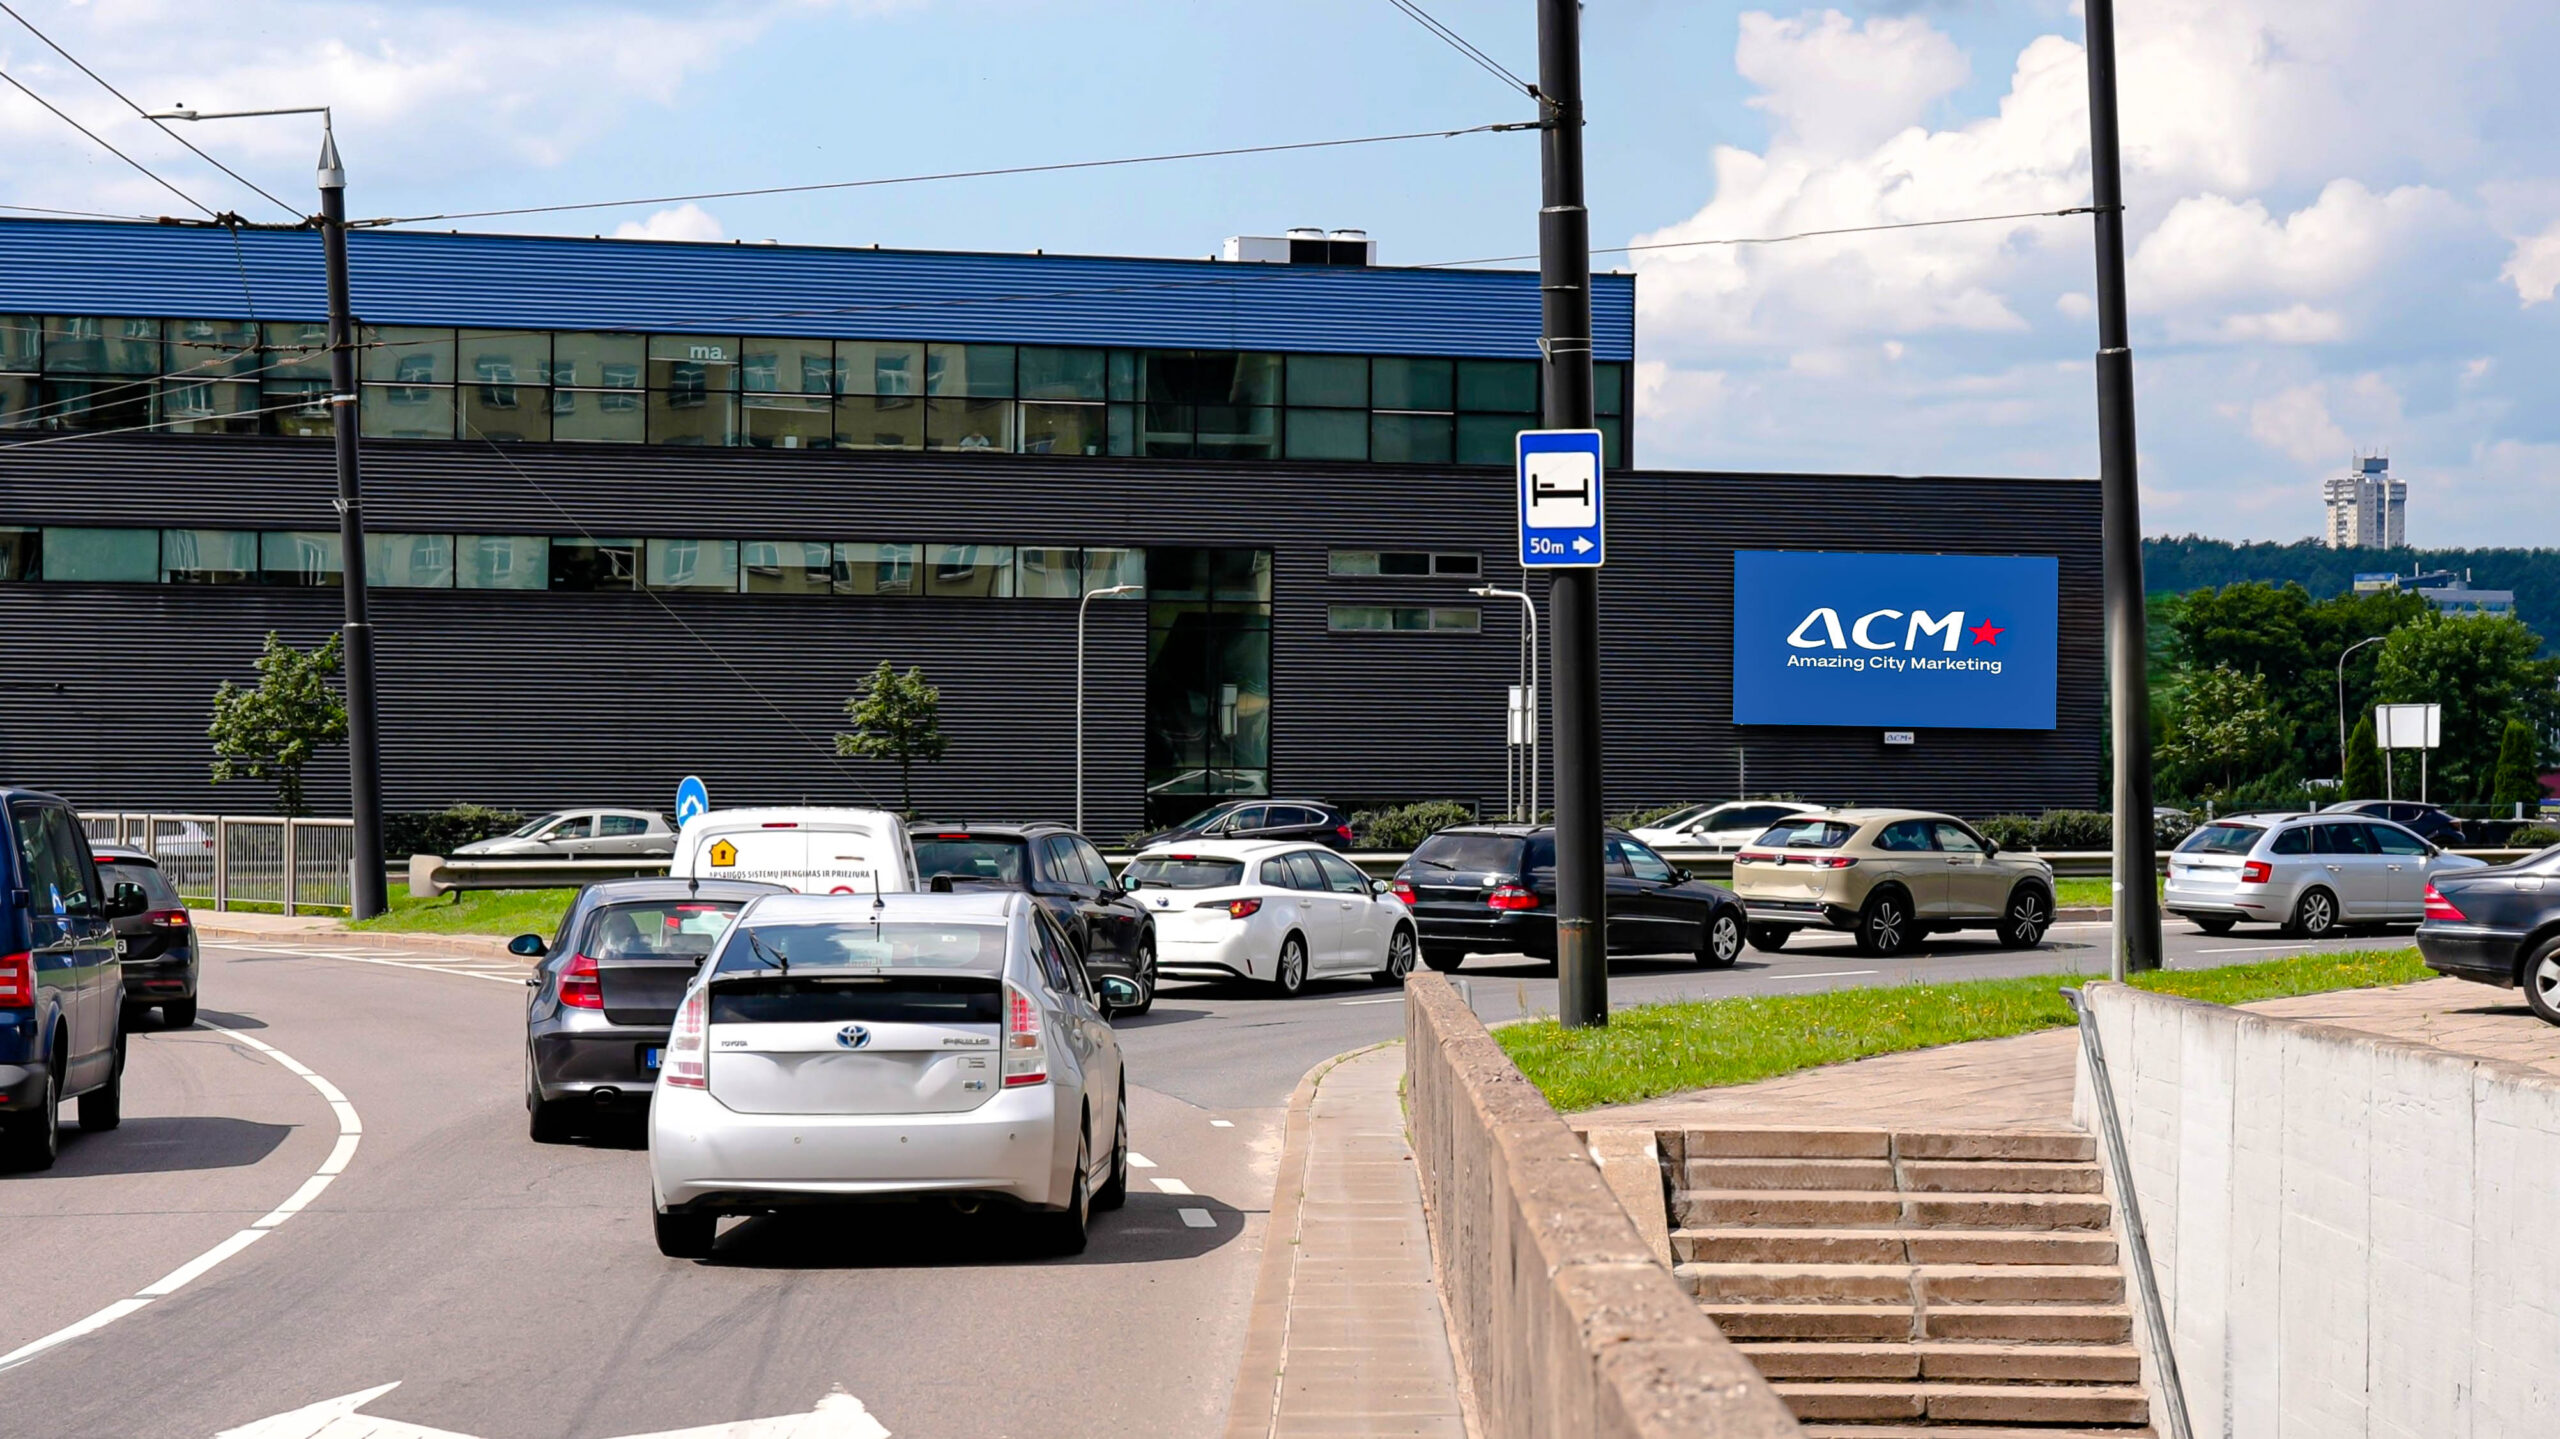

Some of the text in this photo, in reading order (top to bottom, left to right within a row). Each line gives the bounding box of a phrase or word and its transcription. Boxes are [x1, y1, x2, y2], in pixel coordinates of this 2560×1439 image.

[690, 346, 727, 360] ma.
[1530, 538, 1564, 554] 50m
[1786, 607, 1965, 652] ACM
[1787, 654, 2002, 675] Amazing City Marketing
[822, 869, 830, 878] IR
